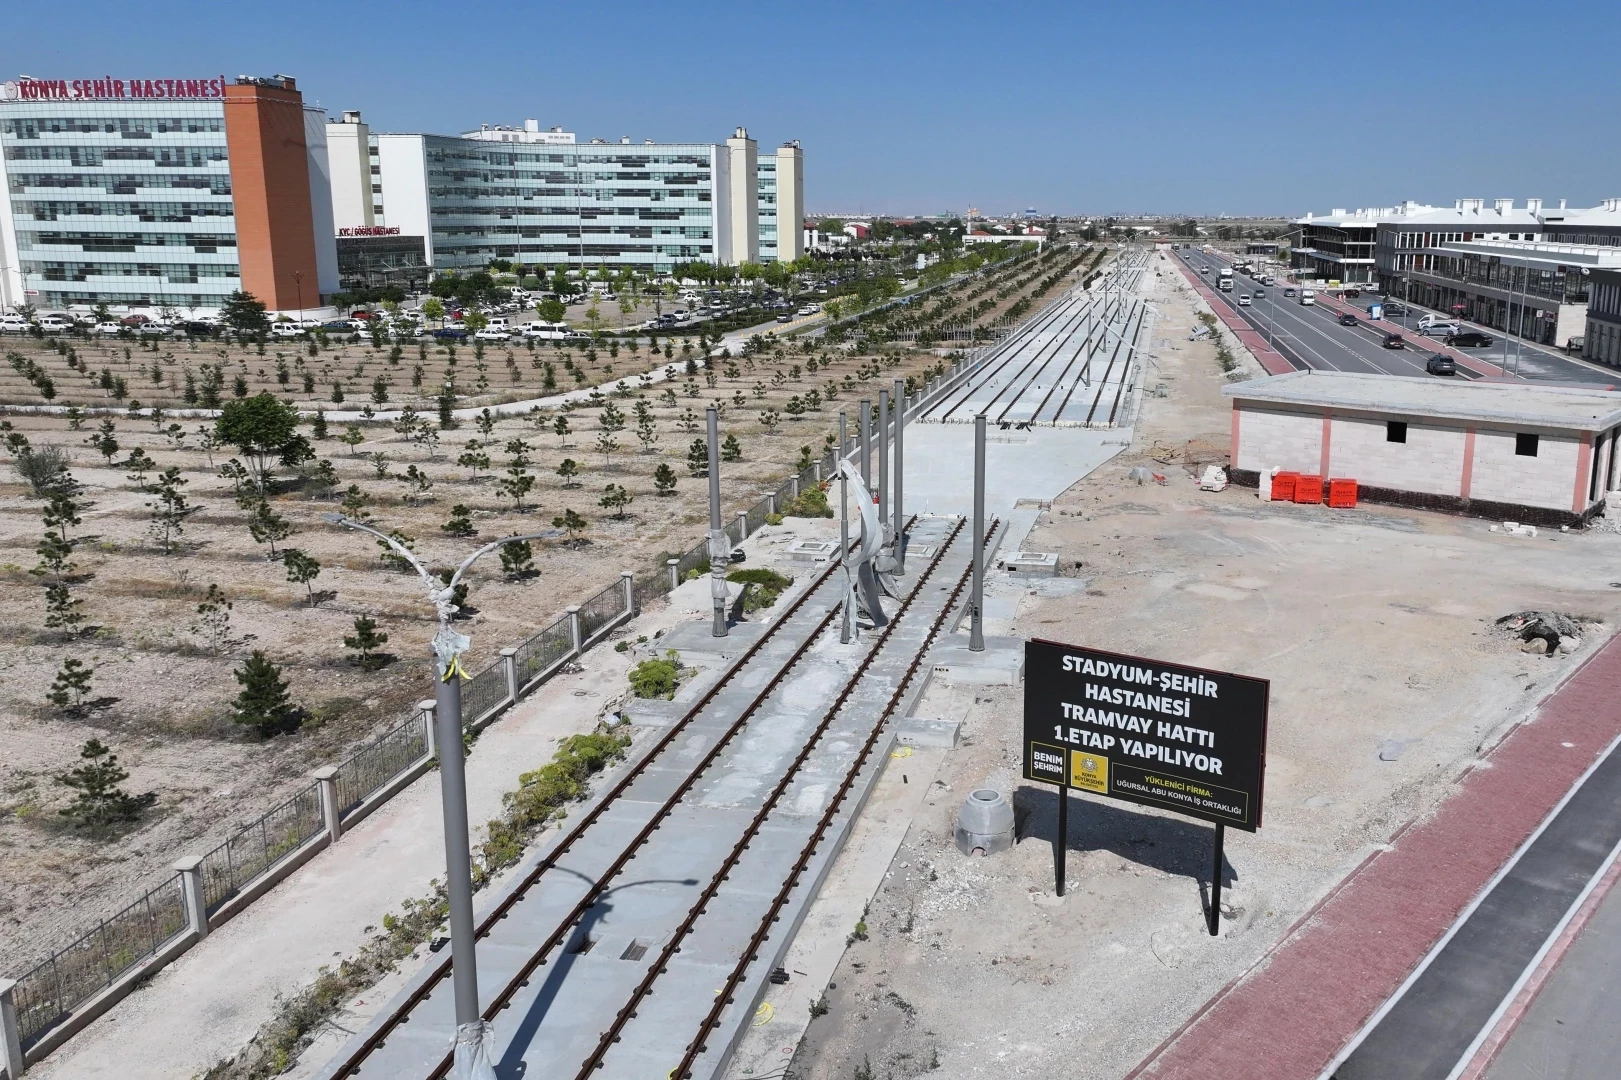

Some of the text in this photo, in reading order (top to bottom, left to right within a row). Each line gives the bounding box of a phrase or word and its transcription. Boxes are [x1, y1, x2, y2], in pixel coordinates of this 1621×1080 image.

[20, 80, 69, 98] KONYA
[129, 74, 226, 98] HASTANESİ
[1062, 655, 1218, 698] STADYUM-ŞEHİR
[1085, 683, 1191, 718] HASTANESİ
[1061, 702, 1215, 748] TRAMVAY HATTI
[1034, 751, 1063, 766] BENİM
[1054, 725, 1223, 776] 1.ETAP YAPILIYOR
[1116, 779, 1242, 815] UĞURSAL ABU KONYA İŞ ORTAKLIĞI
[1144, 775, 1213, 798] YÜKLENİCİ FİRMA:
